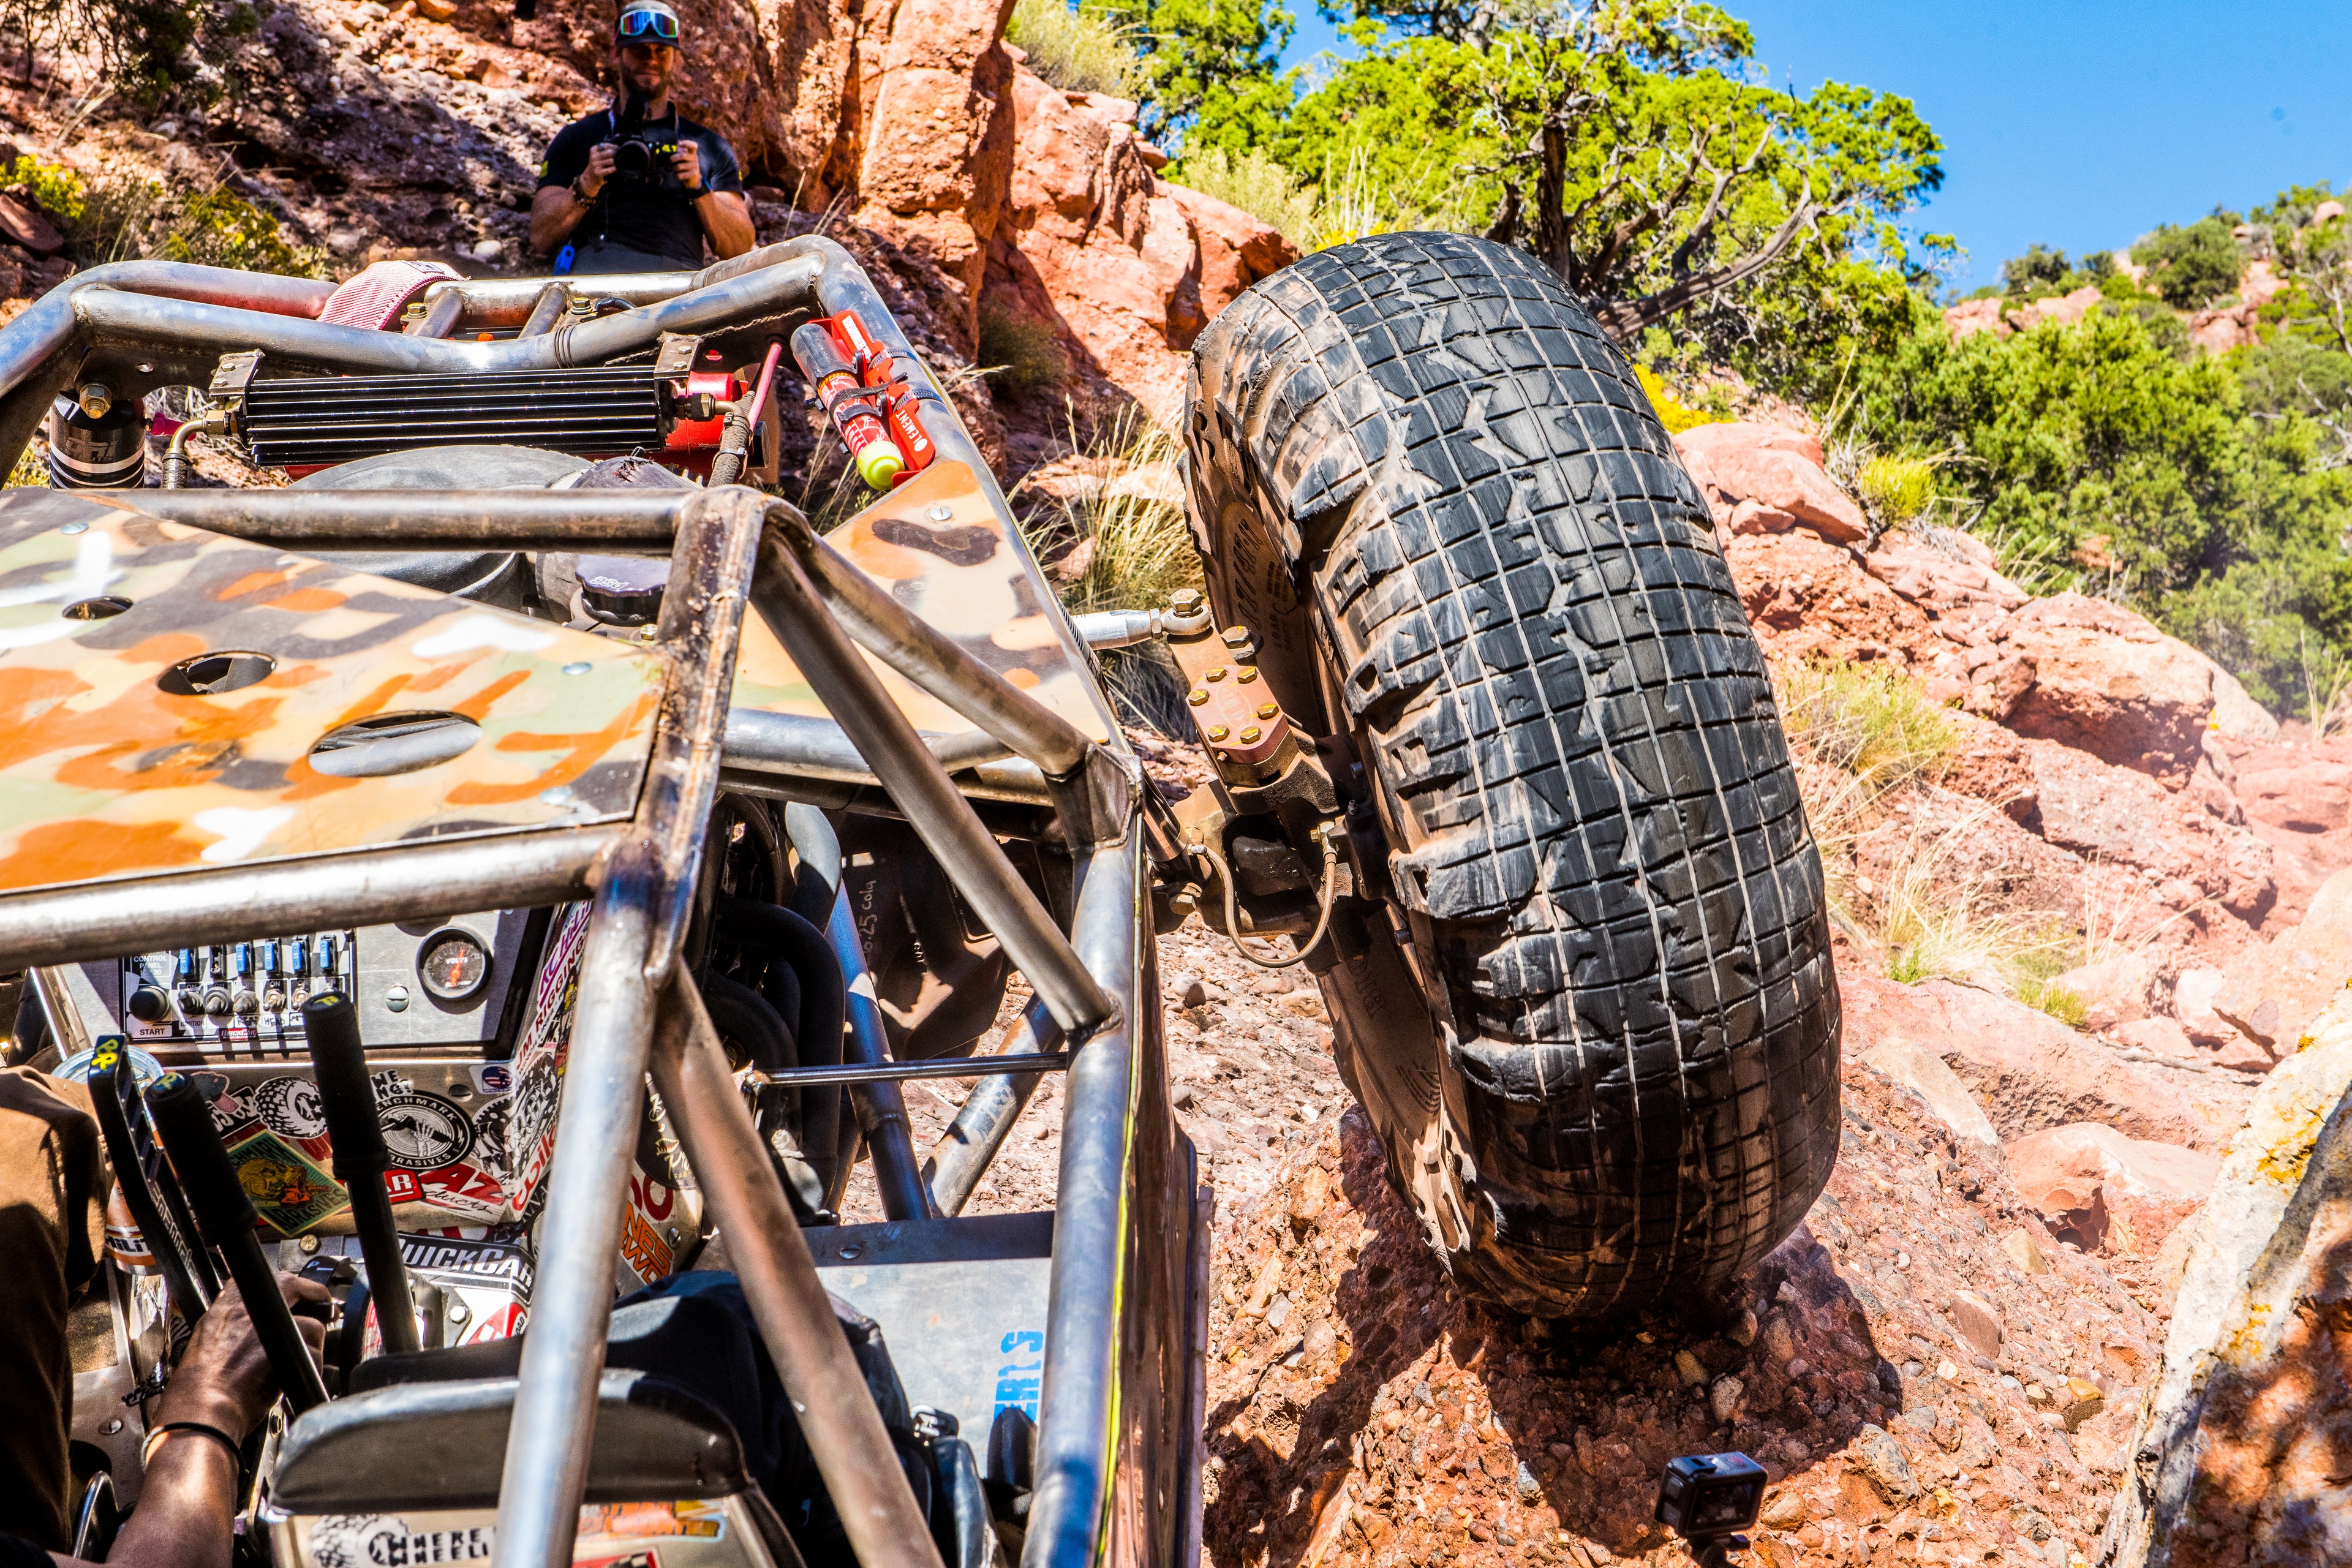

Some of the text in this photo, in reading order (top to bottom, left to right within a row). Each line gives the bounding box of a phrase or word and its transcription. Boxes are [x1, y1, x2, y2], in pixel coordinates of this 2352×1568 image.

[535, 935, 585, 1033] RIGGING
[377, 1097, 458, 1121] ENCHMARK
[390, 1152, 451, 1167] BRASIVES
[389, 1542, 489, 1568] WHEELI
